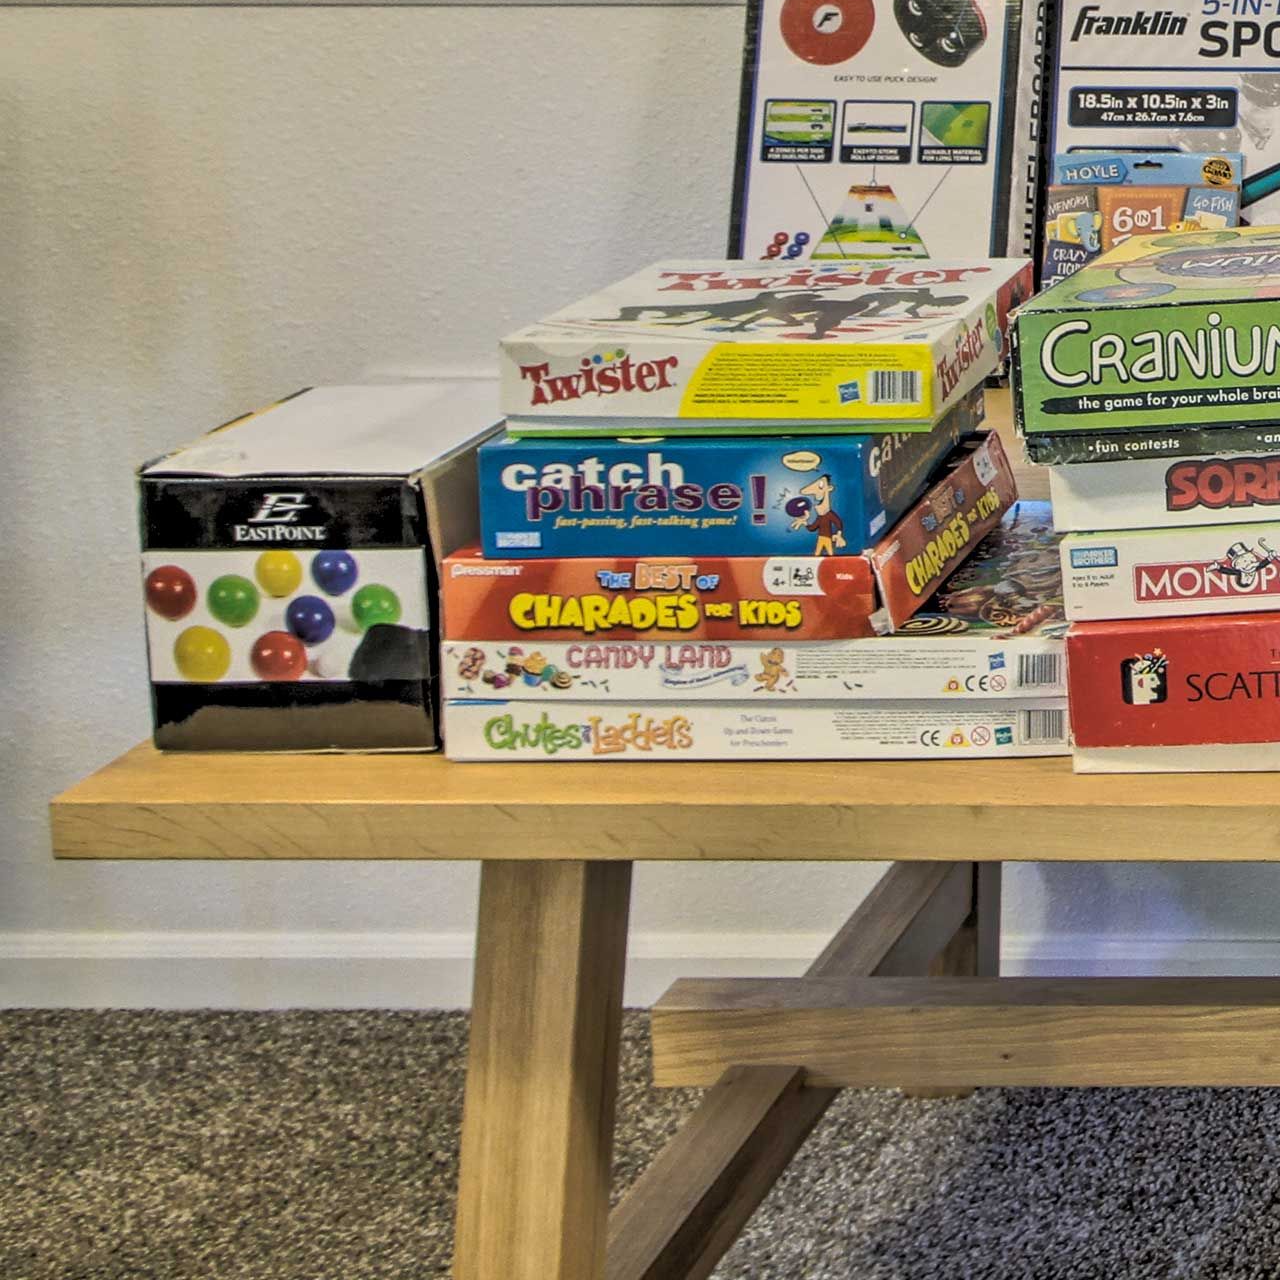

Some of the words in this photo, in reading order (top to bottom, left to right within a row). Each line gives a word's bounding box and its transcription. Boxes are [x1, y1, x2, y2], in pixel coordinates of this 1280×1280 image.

[1079, 94, 1123, 109] 18.5in
[1142, 94, 1188, 110] 10.5in
[1206, 95, 1229, 109] 3in
[1101, 112, 1124, 122] 47cm
[1135, 112, 1168, 122] 26.7cm
[1178, 113, 1204, 122] 7.6cm
[1067, 164, 1118, 180] HOYLE
[1048, 195, 1089, 216] MEMORY
[1193, 195, 1209, 208] GO
[1210, 195, 1234, 211] FISH
[1113, 207, 1133, 232] 6
[1151, 206, 1166, 231] 1
[1053, 248, 1088, 262] CRAZY
[657, 267, 992, 292] Twister
[937, 318, 983, 402] Twister
[519, 354, 679, 406] Twister
[1078, 396, 1101, 410] the
[1104, 397, 1143, 412] game
[1146, 393, 1168, 406] for
[1170, 393, 1204, 410] your
[1206, 390, 1249, 404] whole
[1096, 440, 1119, 452] fun
[1124, 438, 1180, 451] contests
[501, 452, 685, 492] catch
[634, 563, 698, 590] BEST
[696, 575, 719, 589] OF
[509, 592, 700, 632] CHARADES
[705, 603, 733, 617] FOR
[739, 599, 802, 627] KIDS
[566, 645, 654, 669] CANDY
[664, 645, 732, 669] LAND
[484, 711, 583, 754] Chutes
[586, 713, 693, 755] Ladders
